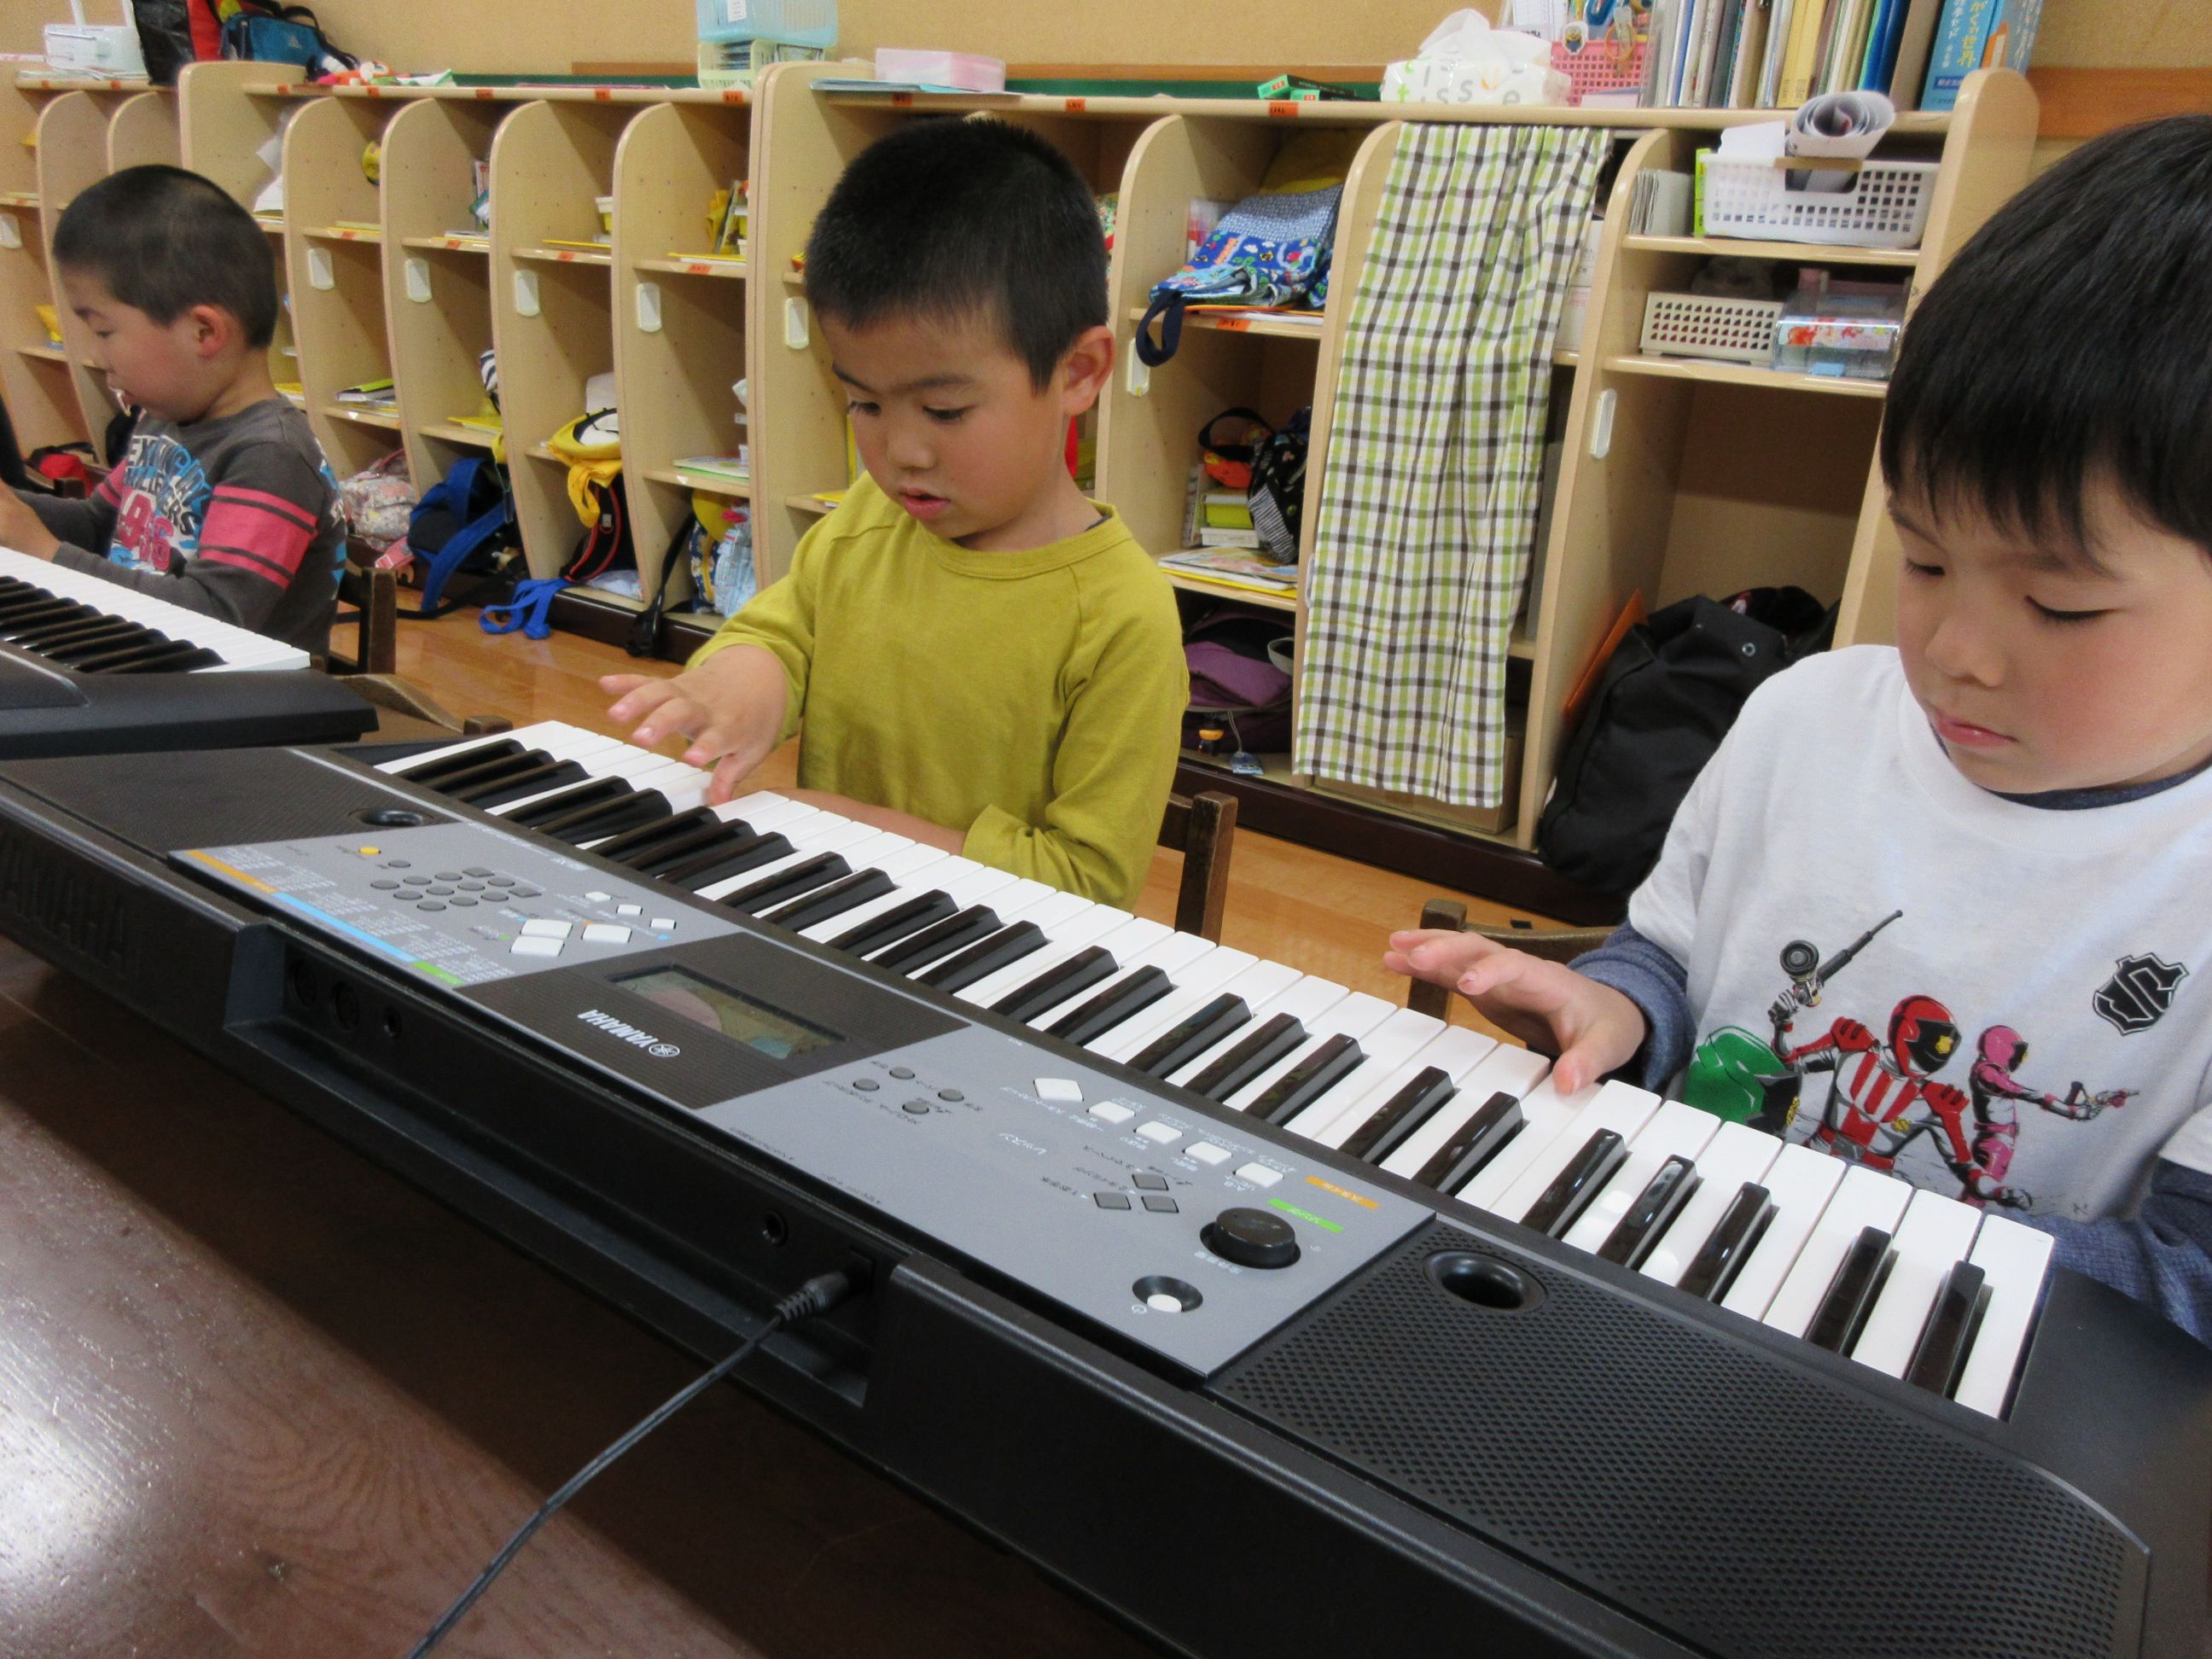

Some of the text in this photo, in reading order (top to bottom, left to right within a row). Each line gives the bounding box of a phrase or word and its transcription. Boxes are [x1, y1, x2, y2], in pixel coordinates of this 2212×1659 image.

[577, 1010, 659, 1048] YAMAHA
[996, 1131, 1049, 1155] レッスン
